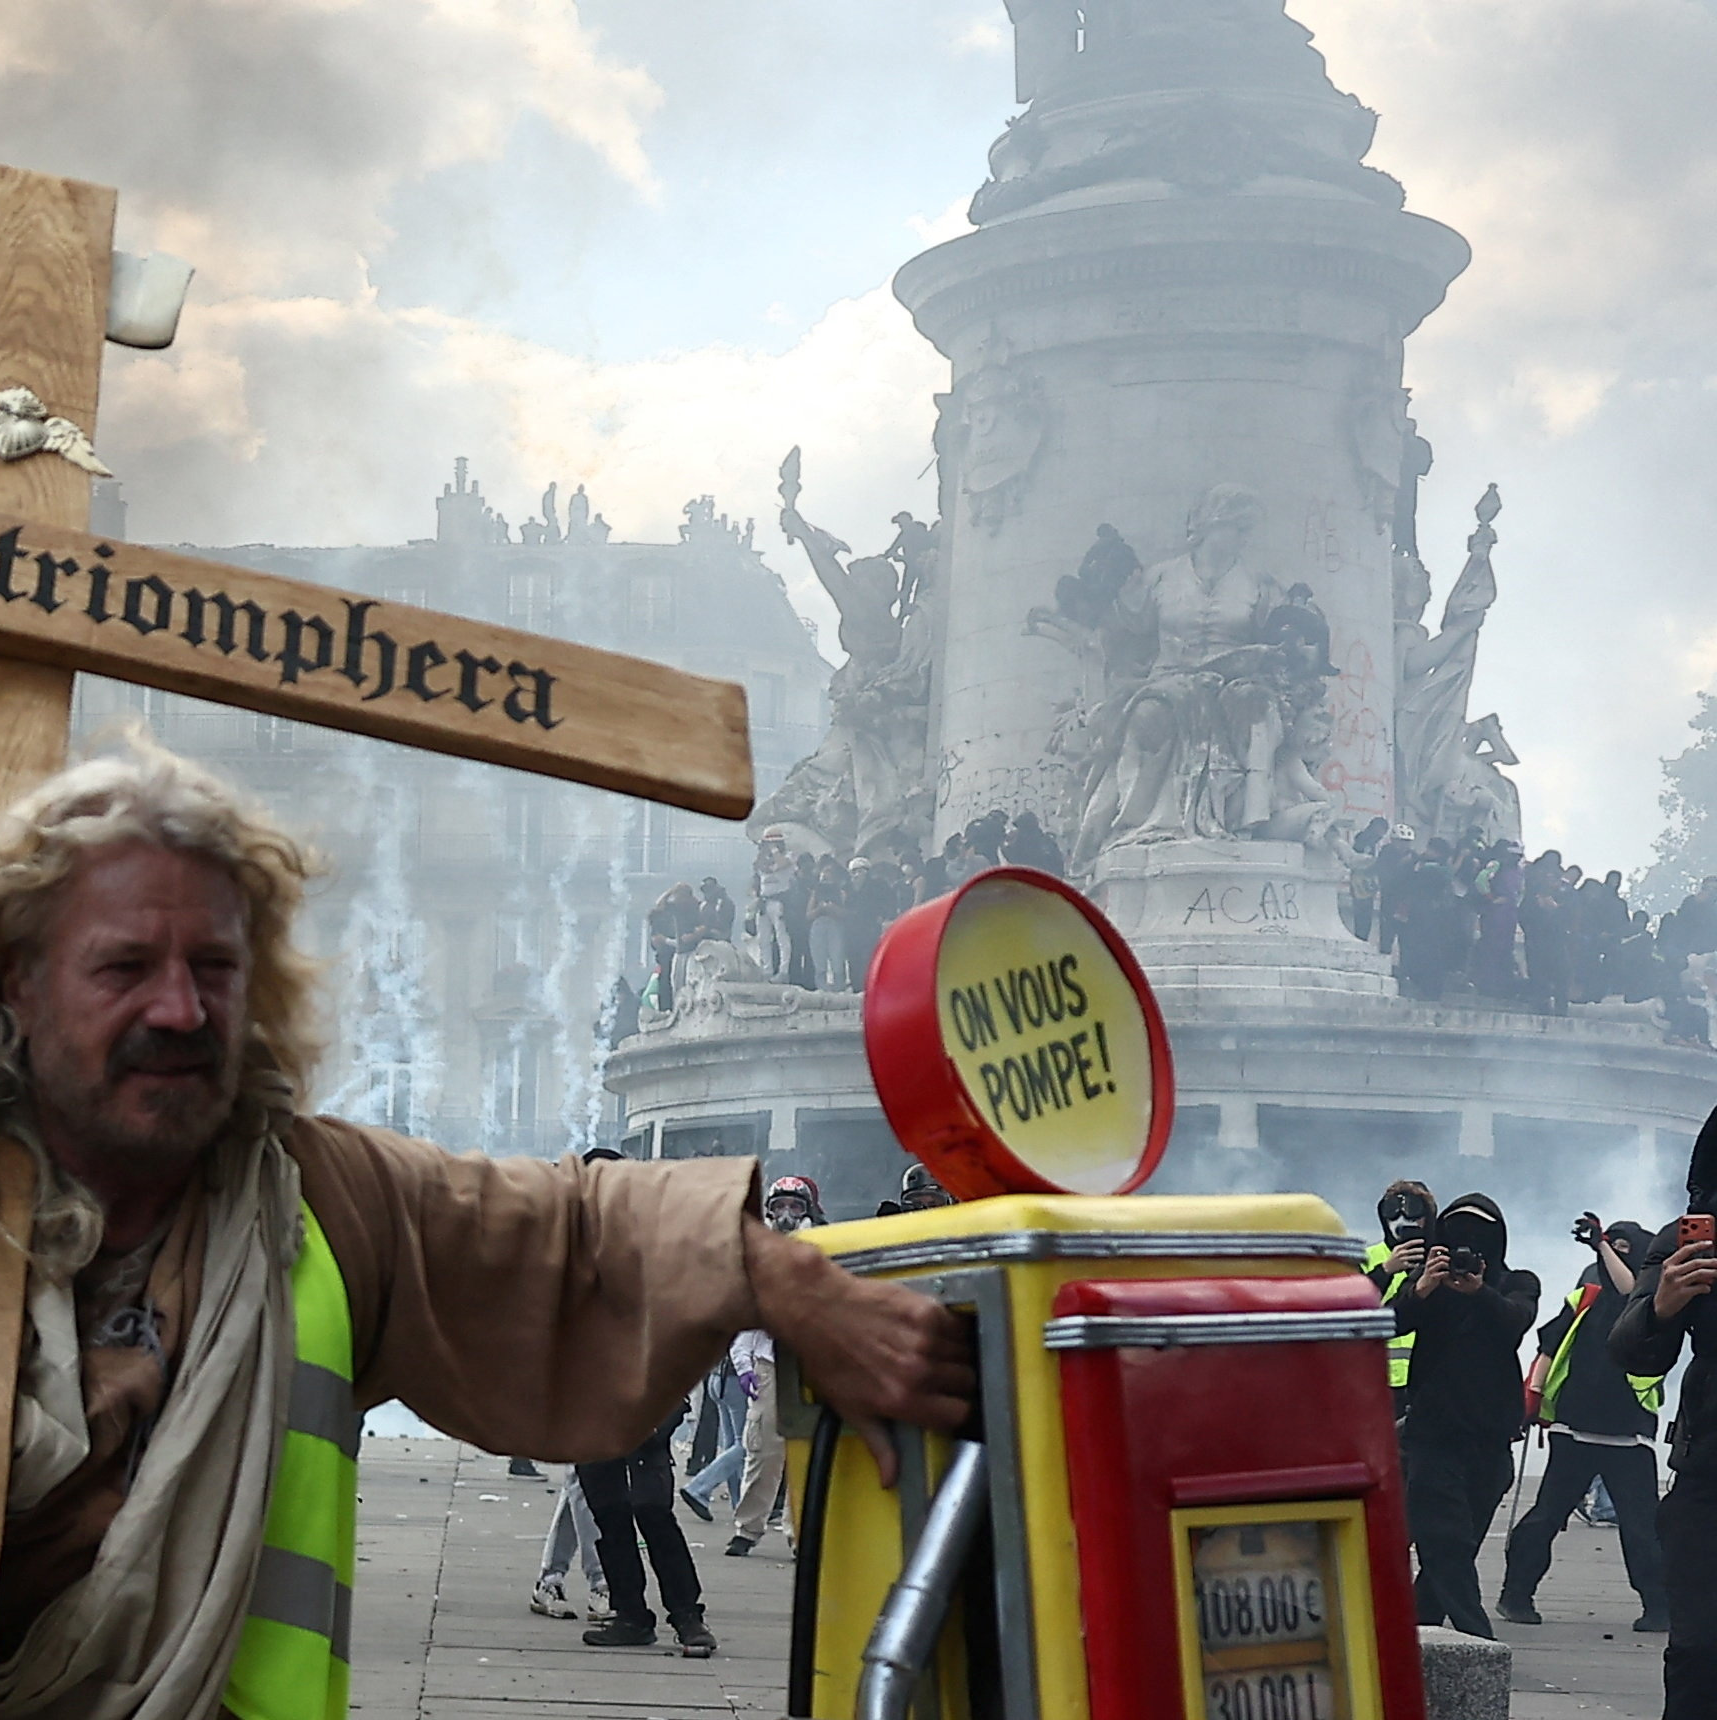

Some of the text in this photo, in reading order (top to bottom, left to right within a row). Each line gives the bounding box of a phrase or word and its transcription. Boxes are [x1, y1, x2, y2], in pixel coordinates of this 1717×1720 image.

[1182, 880, 1300, 925] ACAB
[950, 953, 1089, 1052] ON VOUS
[980, 1021, 1117, 1131] POMPE!
[1305, 1579, 1322, 1622] €
